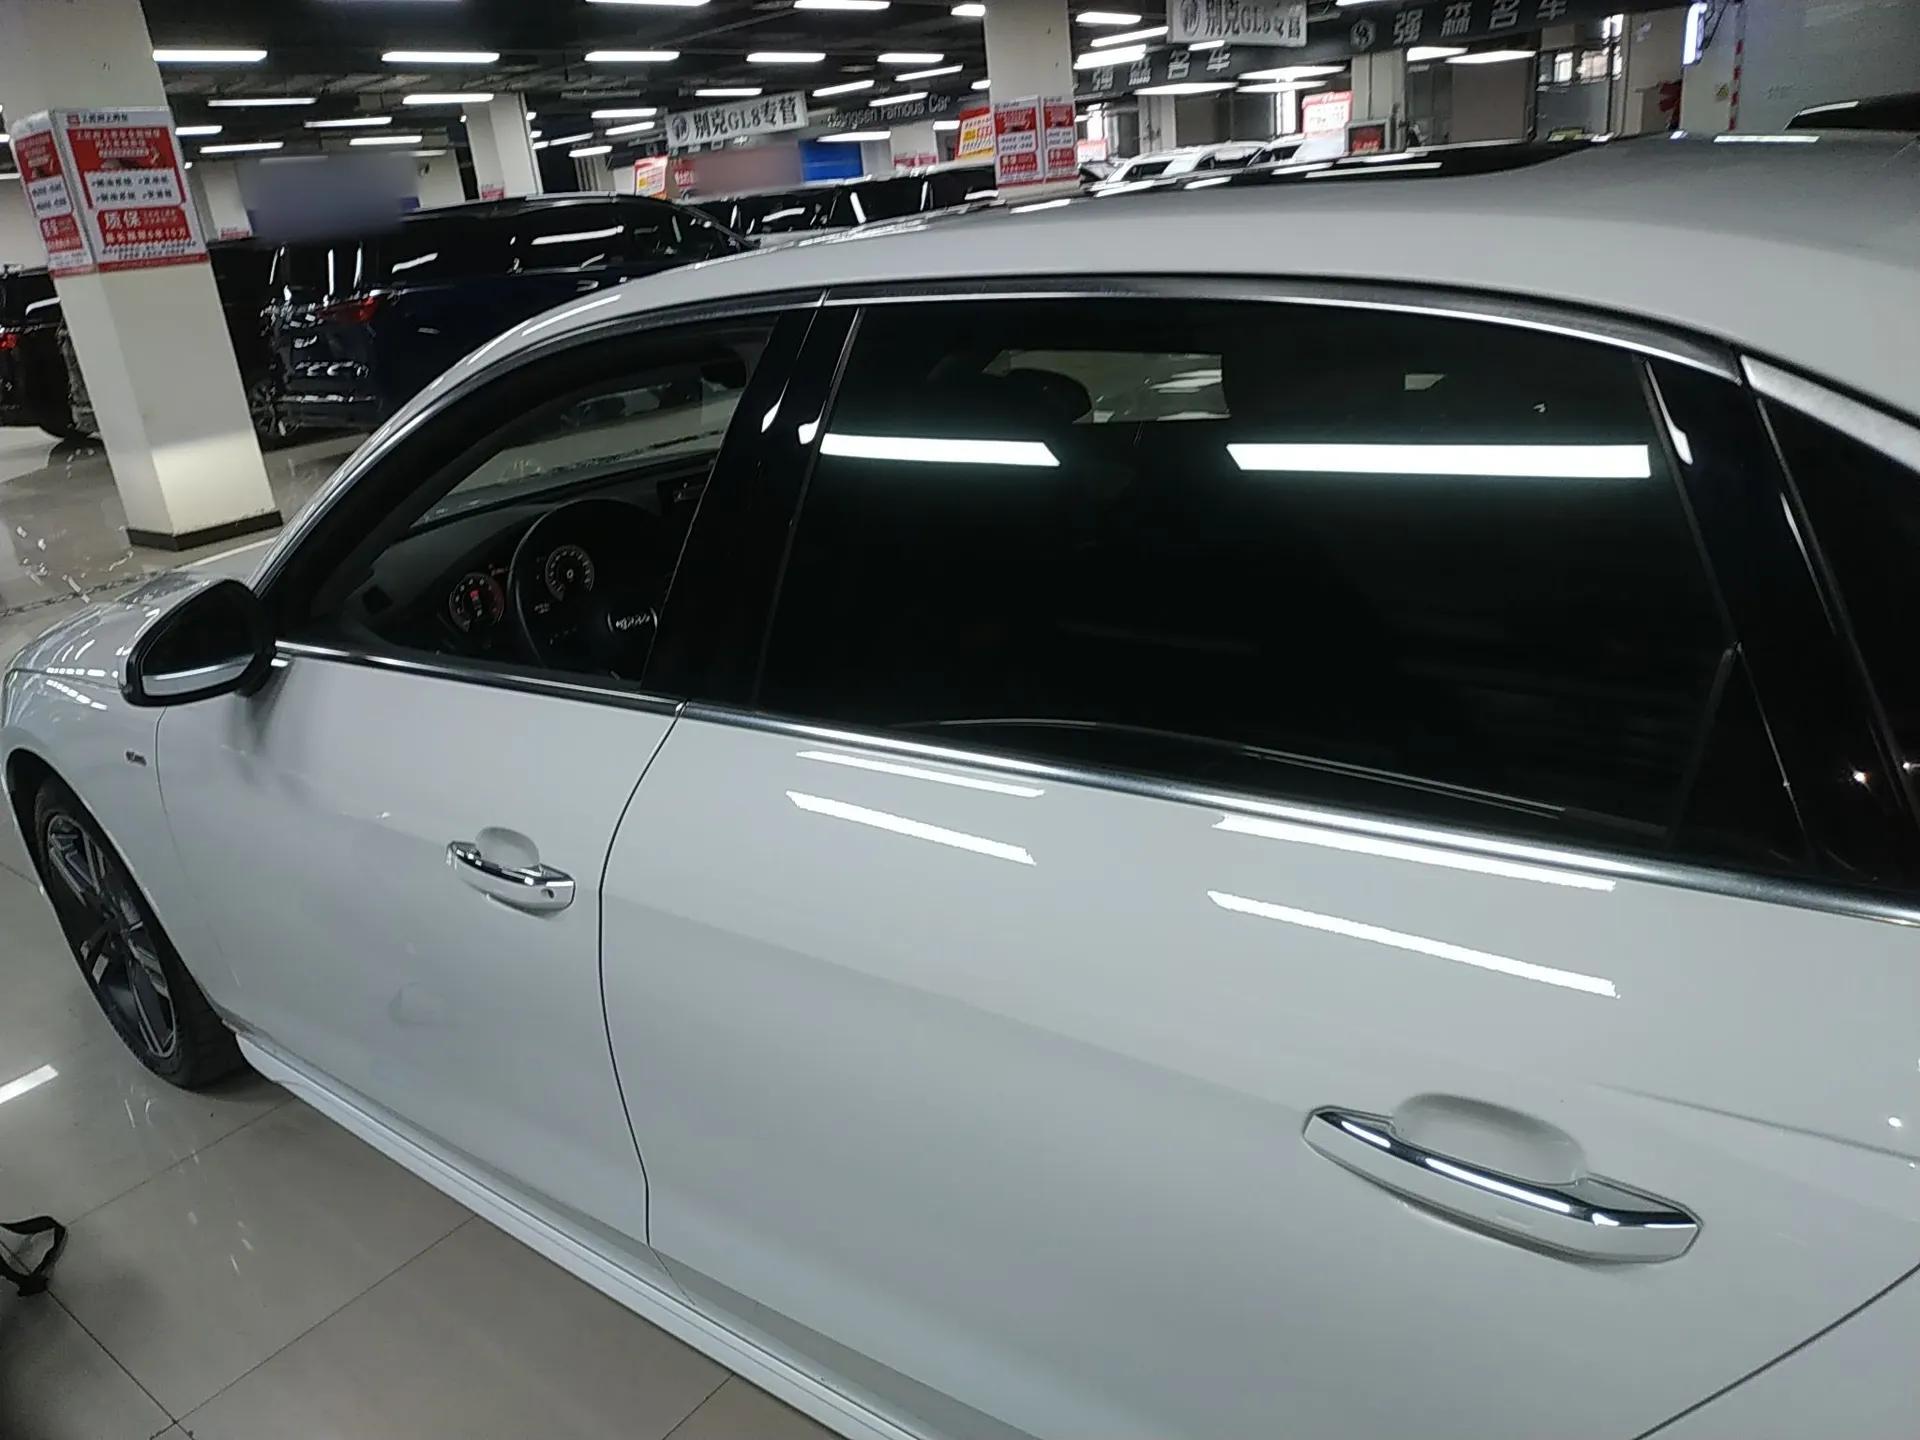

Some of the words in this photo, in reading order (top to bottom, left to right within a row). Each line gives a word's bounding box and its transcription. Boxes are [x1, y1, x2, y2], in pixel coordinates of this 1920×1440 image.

[1393, 0, 1567, 45] 强森名车
[881, 100, 925, 121] Famous
[929, 94, 951, 113] Car
